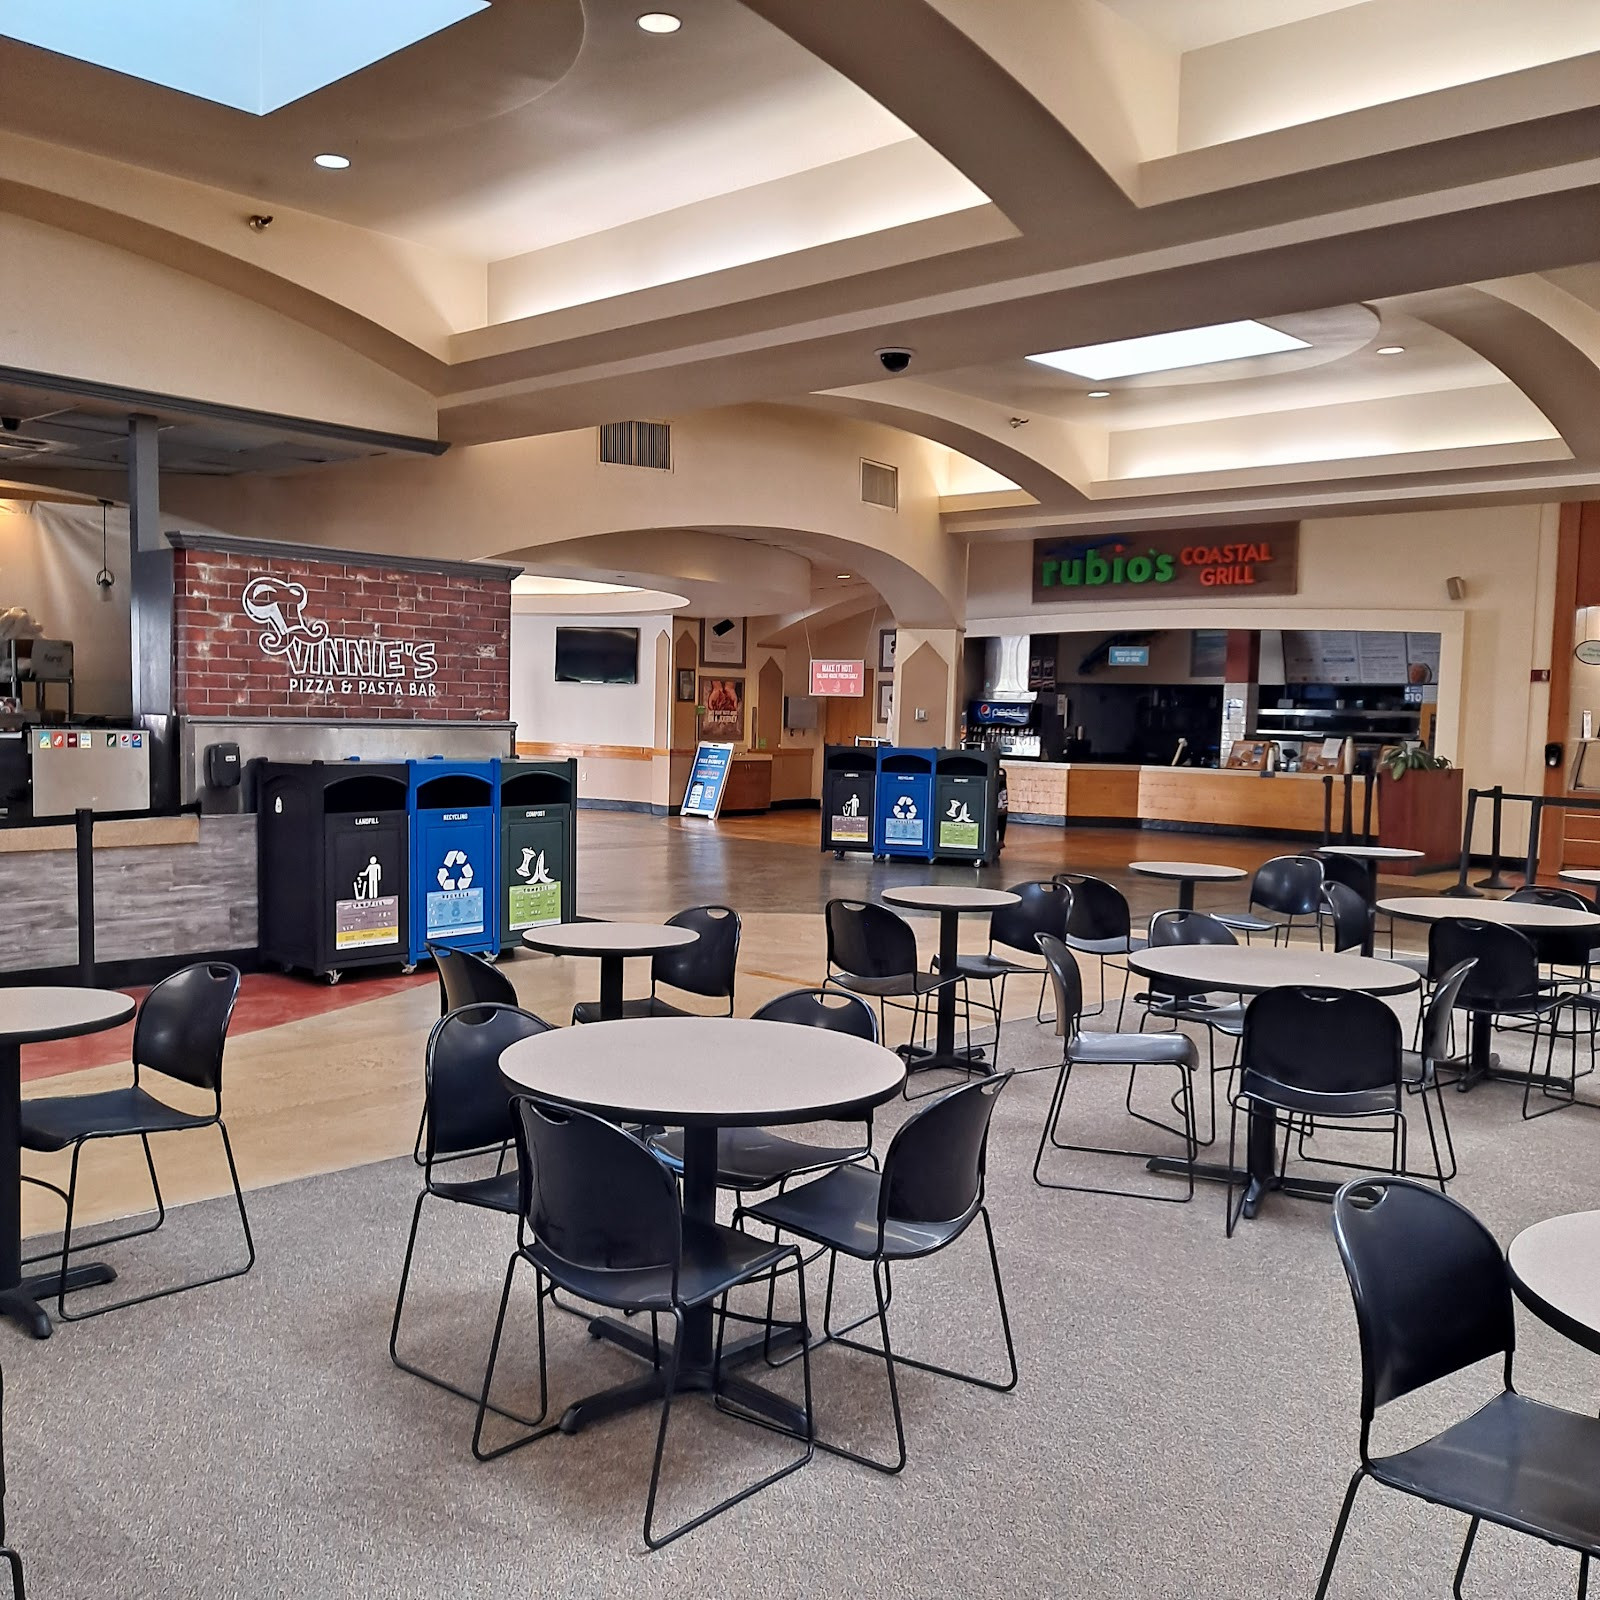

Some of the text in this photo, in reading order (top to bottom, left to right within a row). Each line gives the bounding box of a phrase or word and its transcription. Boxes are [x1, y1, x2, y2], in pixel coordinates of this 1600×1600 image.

[1180, 543, 1273, 566] COASTAL
[1042, 544, 1176, 587] rubio's
[1200, 566, 1255, 586] GRILL
[286, 636, 438, 680] VINNIE'S
[822, 664, 835, 673] MAKE
[289, 678, 437, 697] PIZZA & PASTA BAR
[355, 817, 379, 826] LANDFILL
[443, 813, 468, 821] RECYCLING
[525, 810, 546, 818] COMPOST
